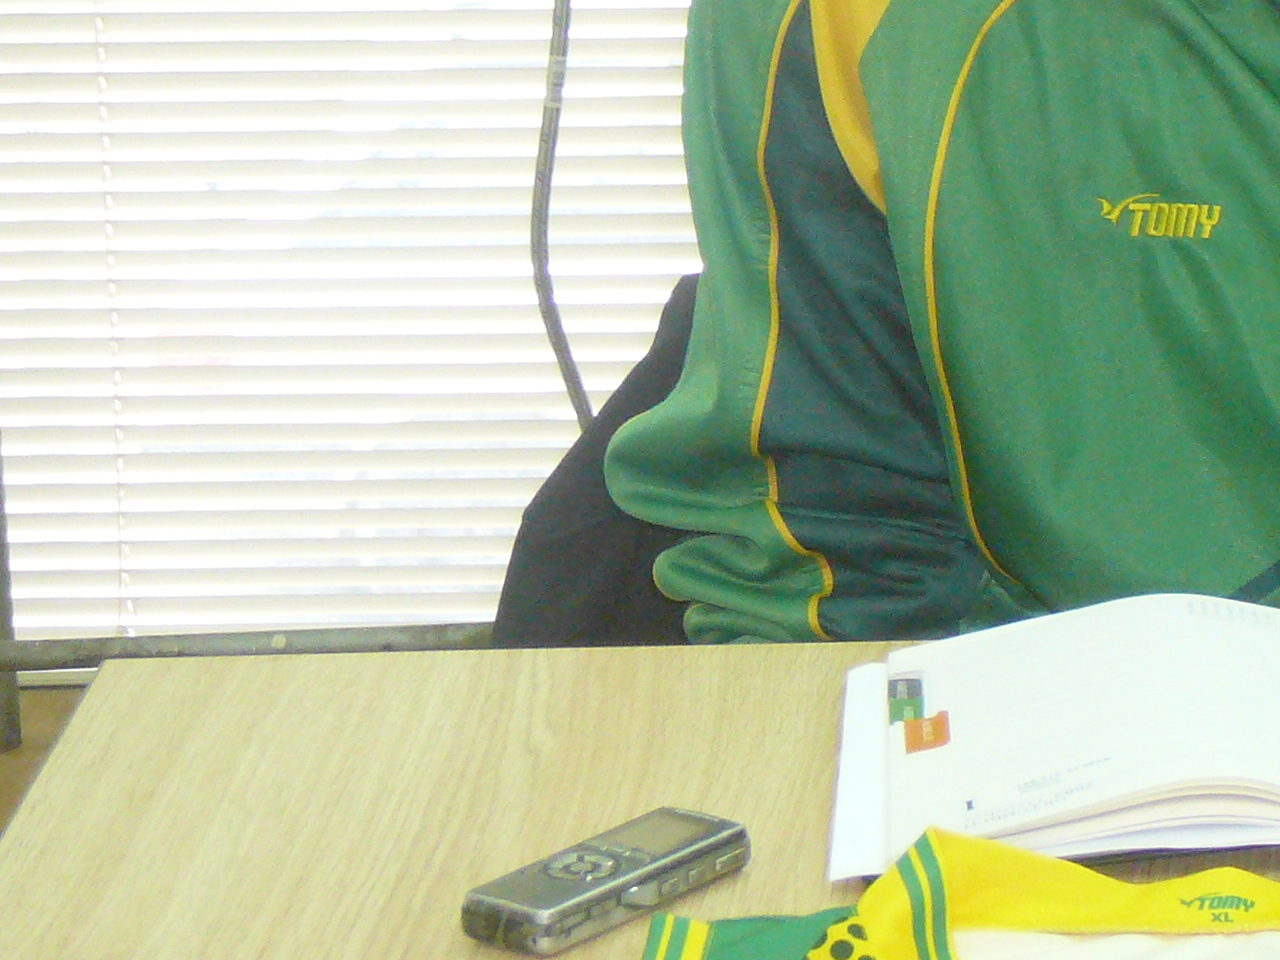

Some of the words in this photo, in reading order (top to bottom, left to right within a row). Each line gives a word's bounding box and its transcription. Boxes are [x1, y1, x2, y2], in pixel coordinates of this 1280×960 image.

[1128, 202, 1222, 239] TOMY
[1197, 895, 1255, 913] TOMY
[1211, 911, 1235, 923] XL
